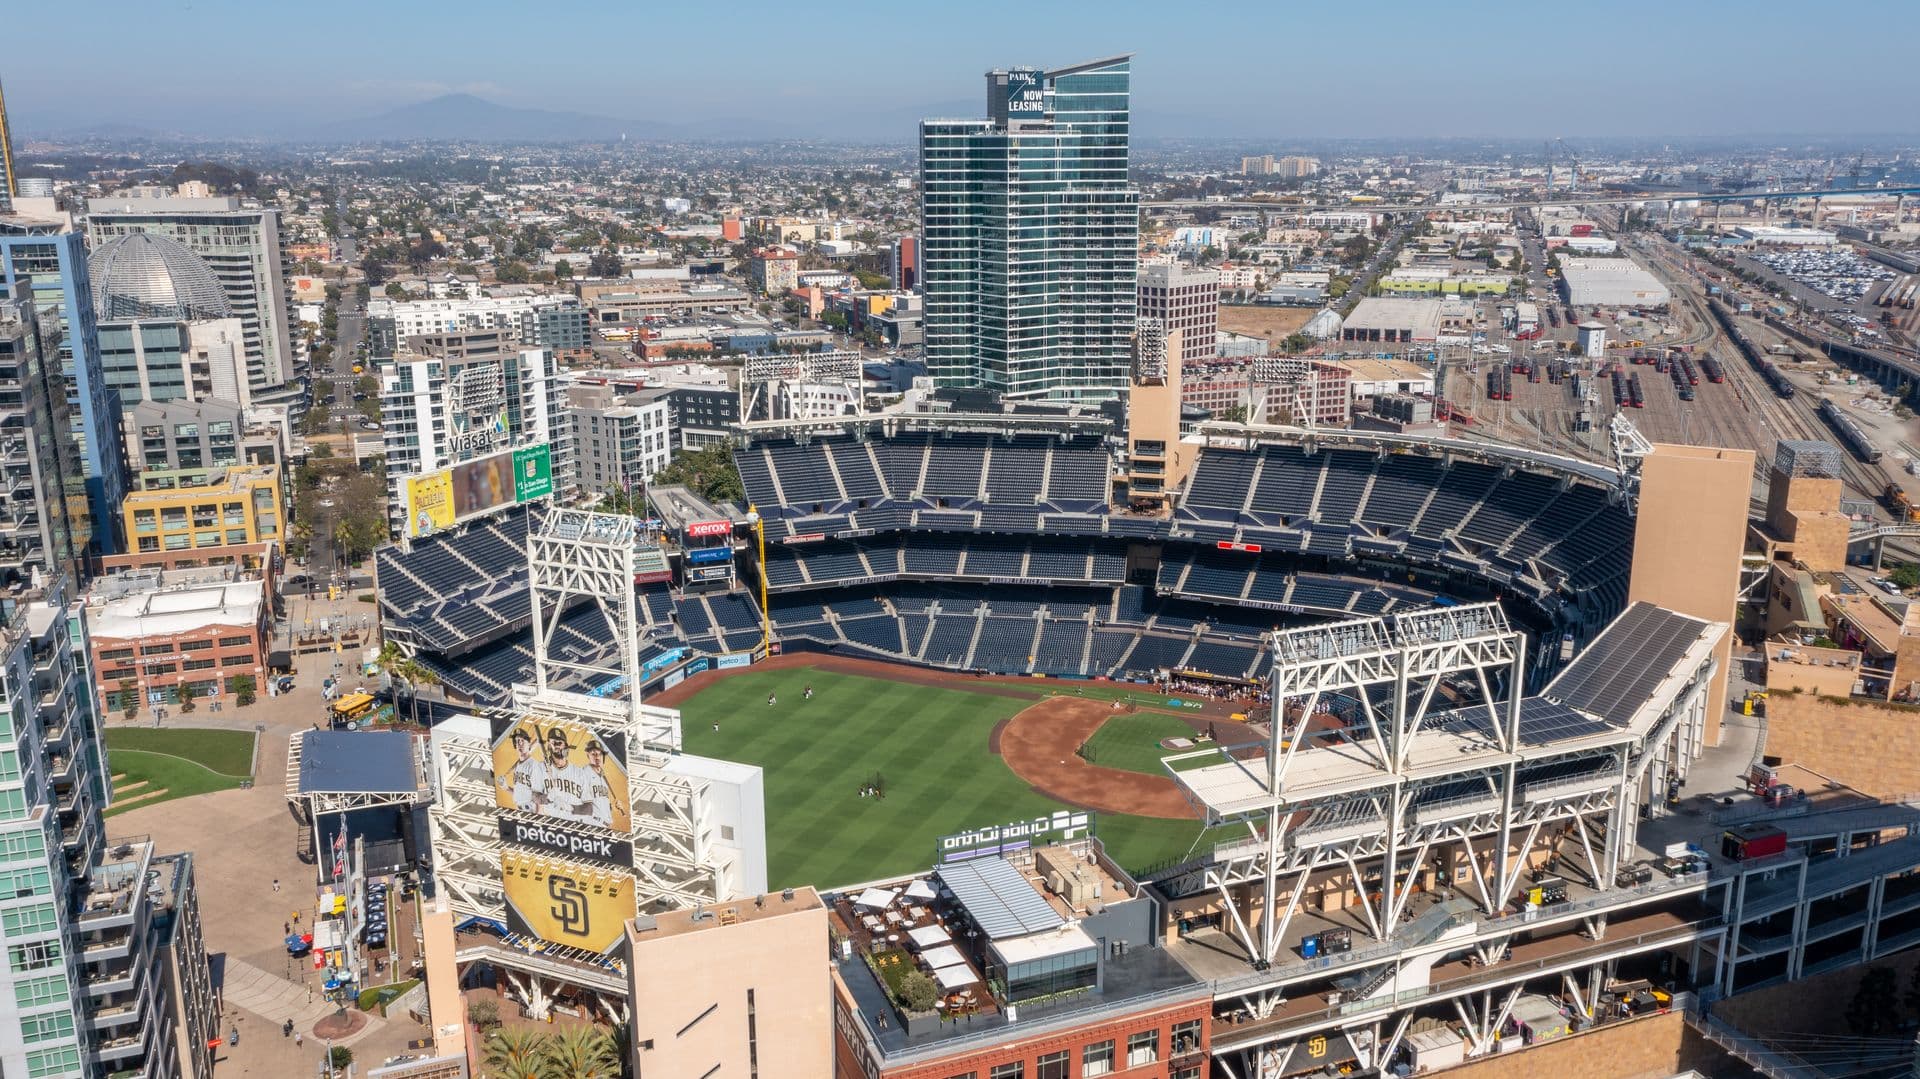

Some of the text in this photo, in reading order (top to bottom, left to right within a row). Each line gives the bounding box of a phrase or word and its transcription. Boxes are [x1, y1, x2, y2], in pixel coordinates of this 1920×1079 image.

[1009, 73, 1030, 81] PARK
[1023, 90, 1043, 100] NOW
[1008, 101, 1043, 112] LEASING
[449, 431, 493, 452] Viasat
[694, 523, 727, 535] xerox
[719, 657, 739, 666] petco
[516, 824, 613, 858] petco park
[548, 874, 590, 937] SD
[836, 1003, 865, 1066] SUPPLY
[1308, 1036, 1327, 1058] SD
